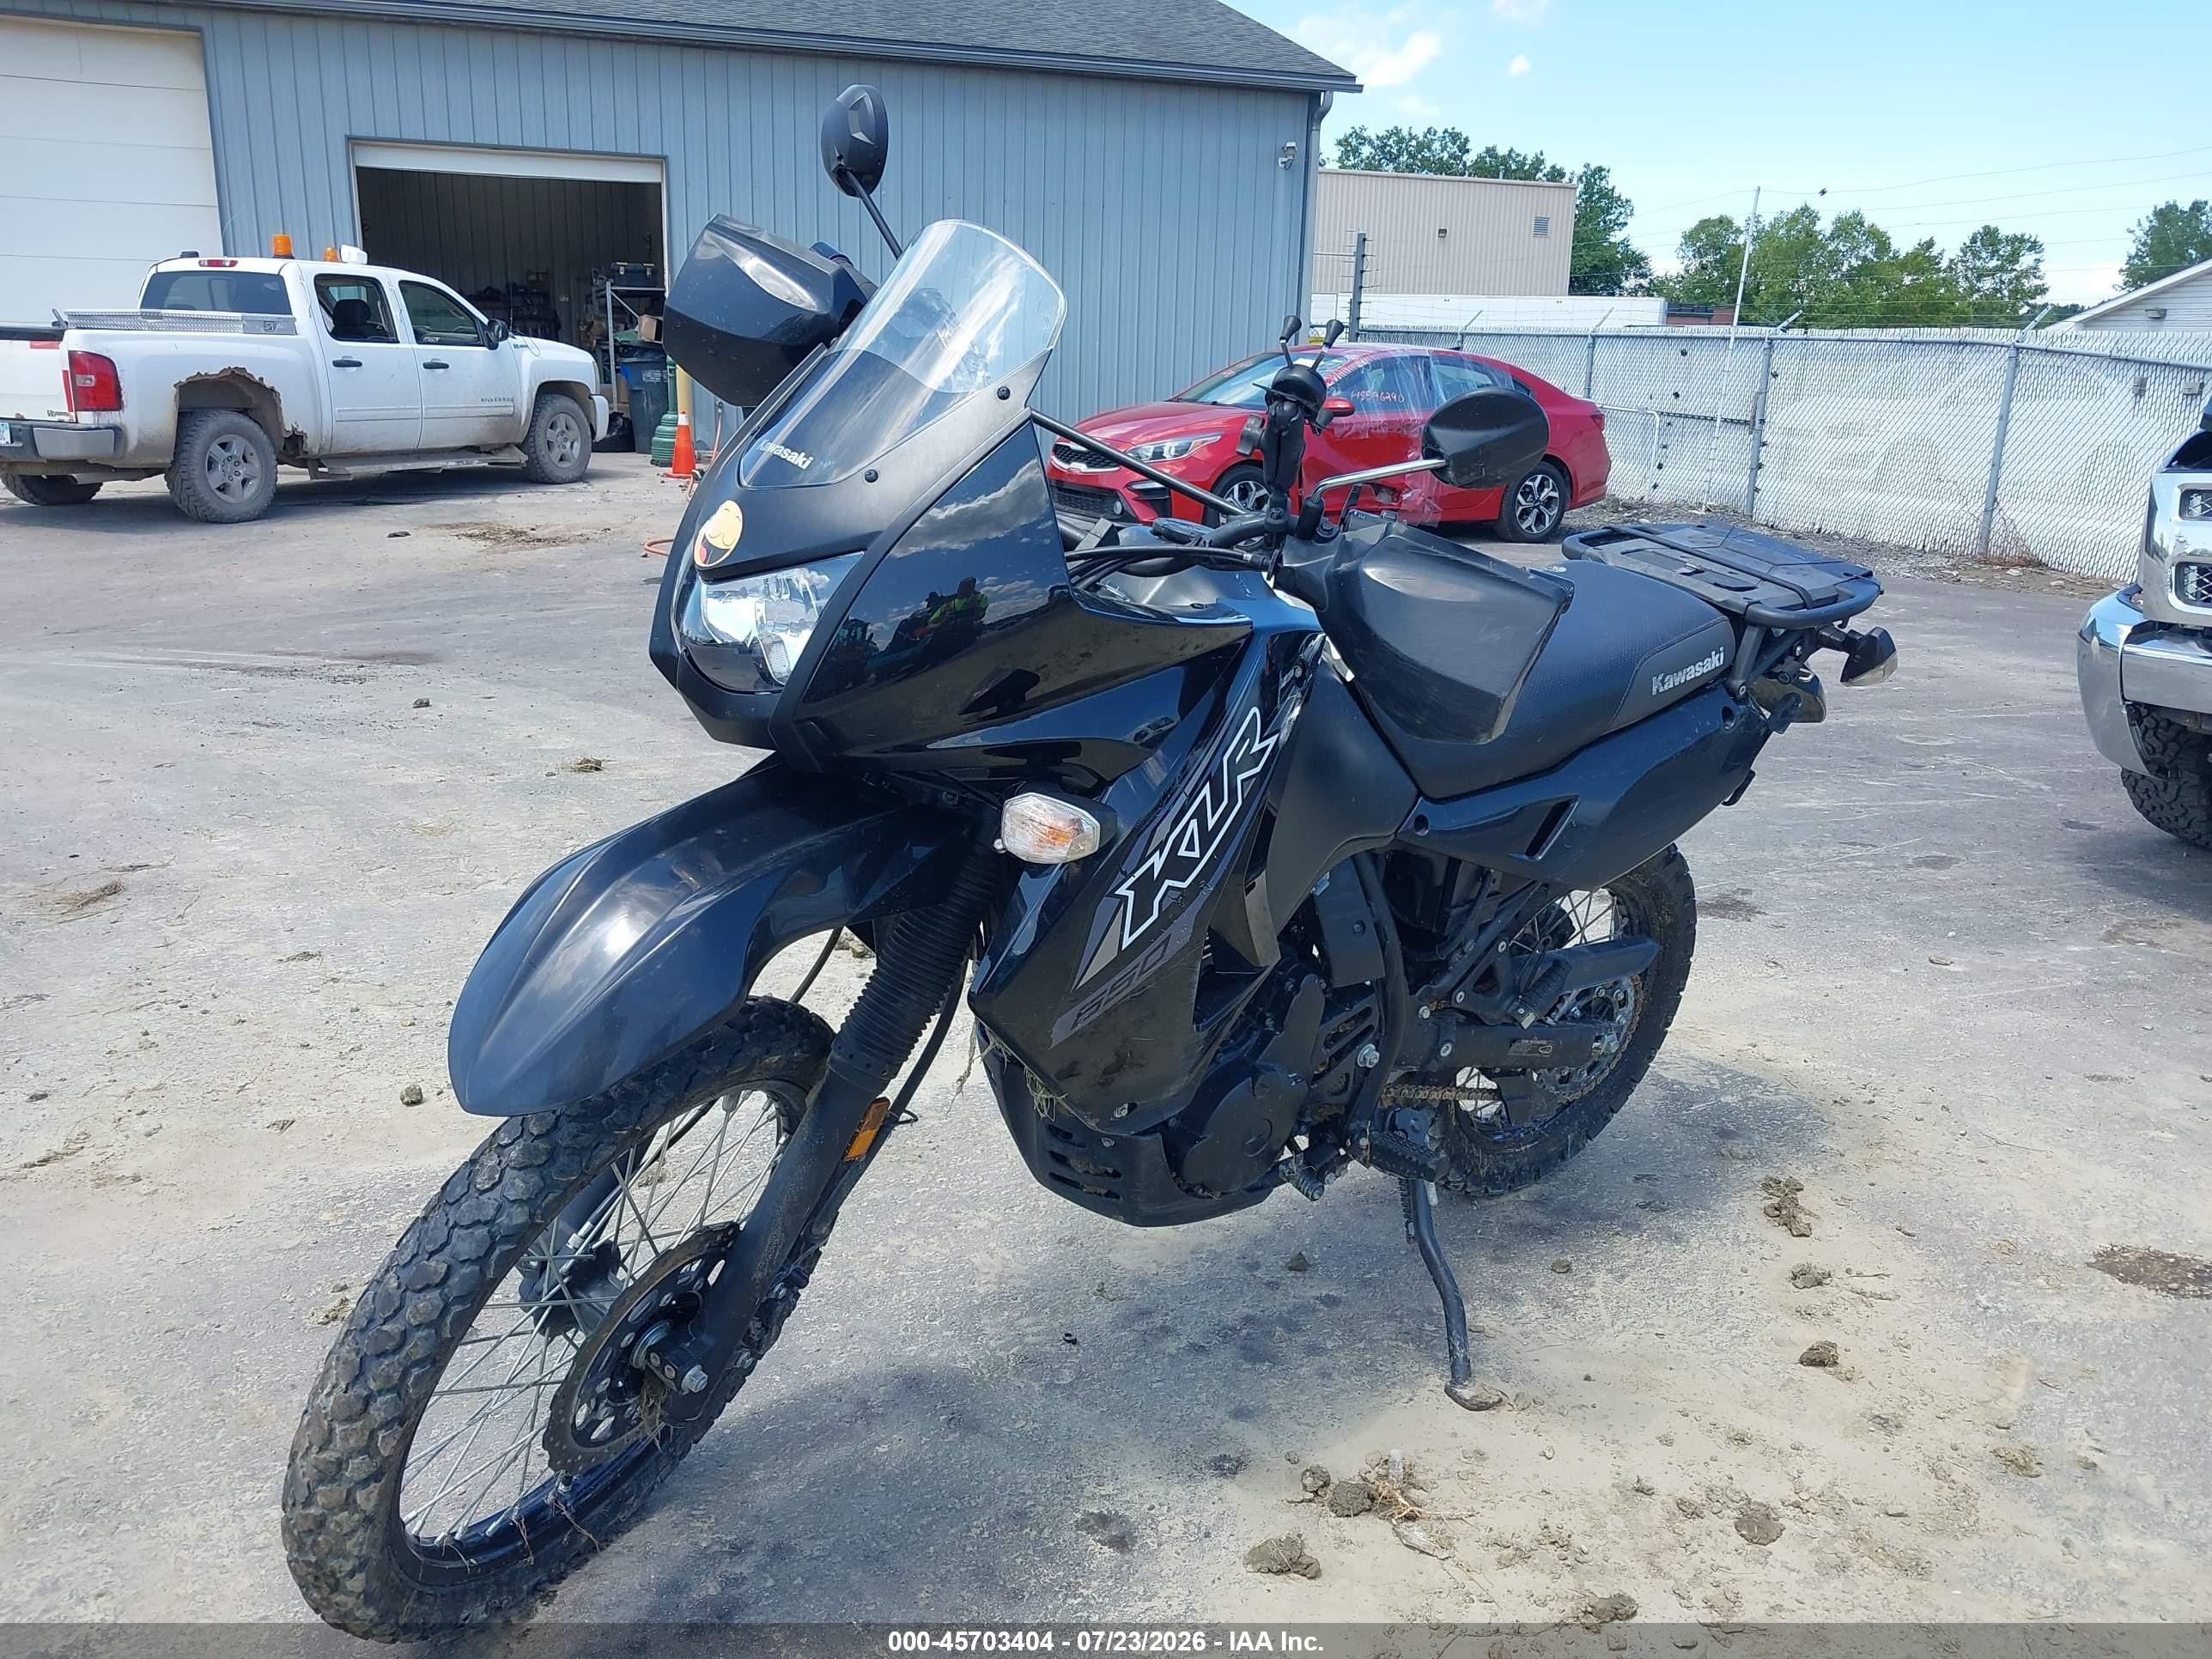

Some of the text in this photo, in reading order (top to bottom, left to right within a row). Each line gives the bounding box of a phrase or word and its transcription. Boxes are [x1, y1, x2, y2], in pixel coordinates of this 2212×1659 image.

[1651, 646, 1724, 696] Kawasaki
[1115, 706, 1279, 951] KLR
[1070, 933, 1172, 1031] 650
